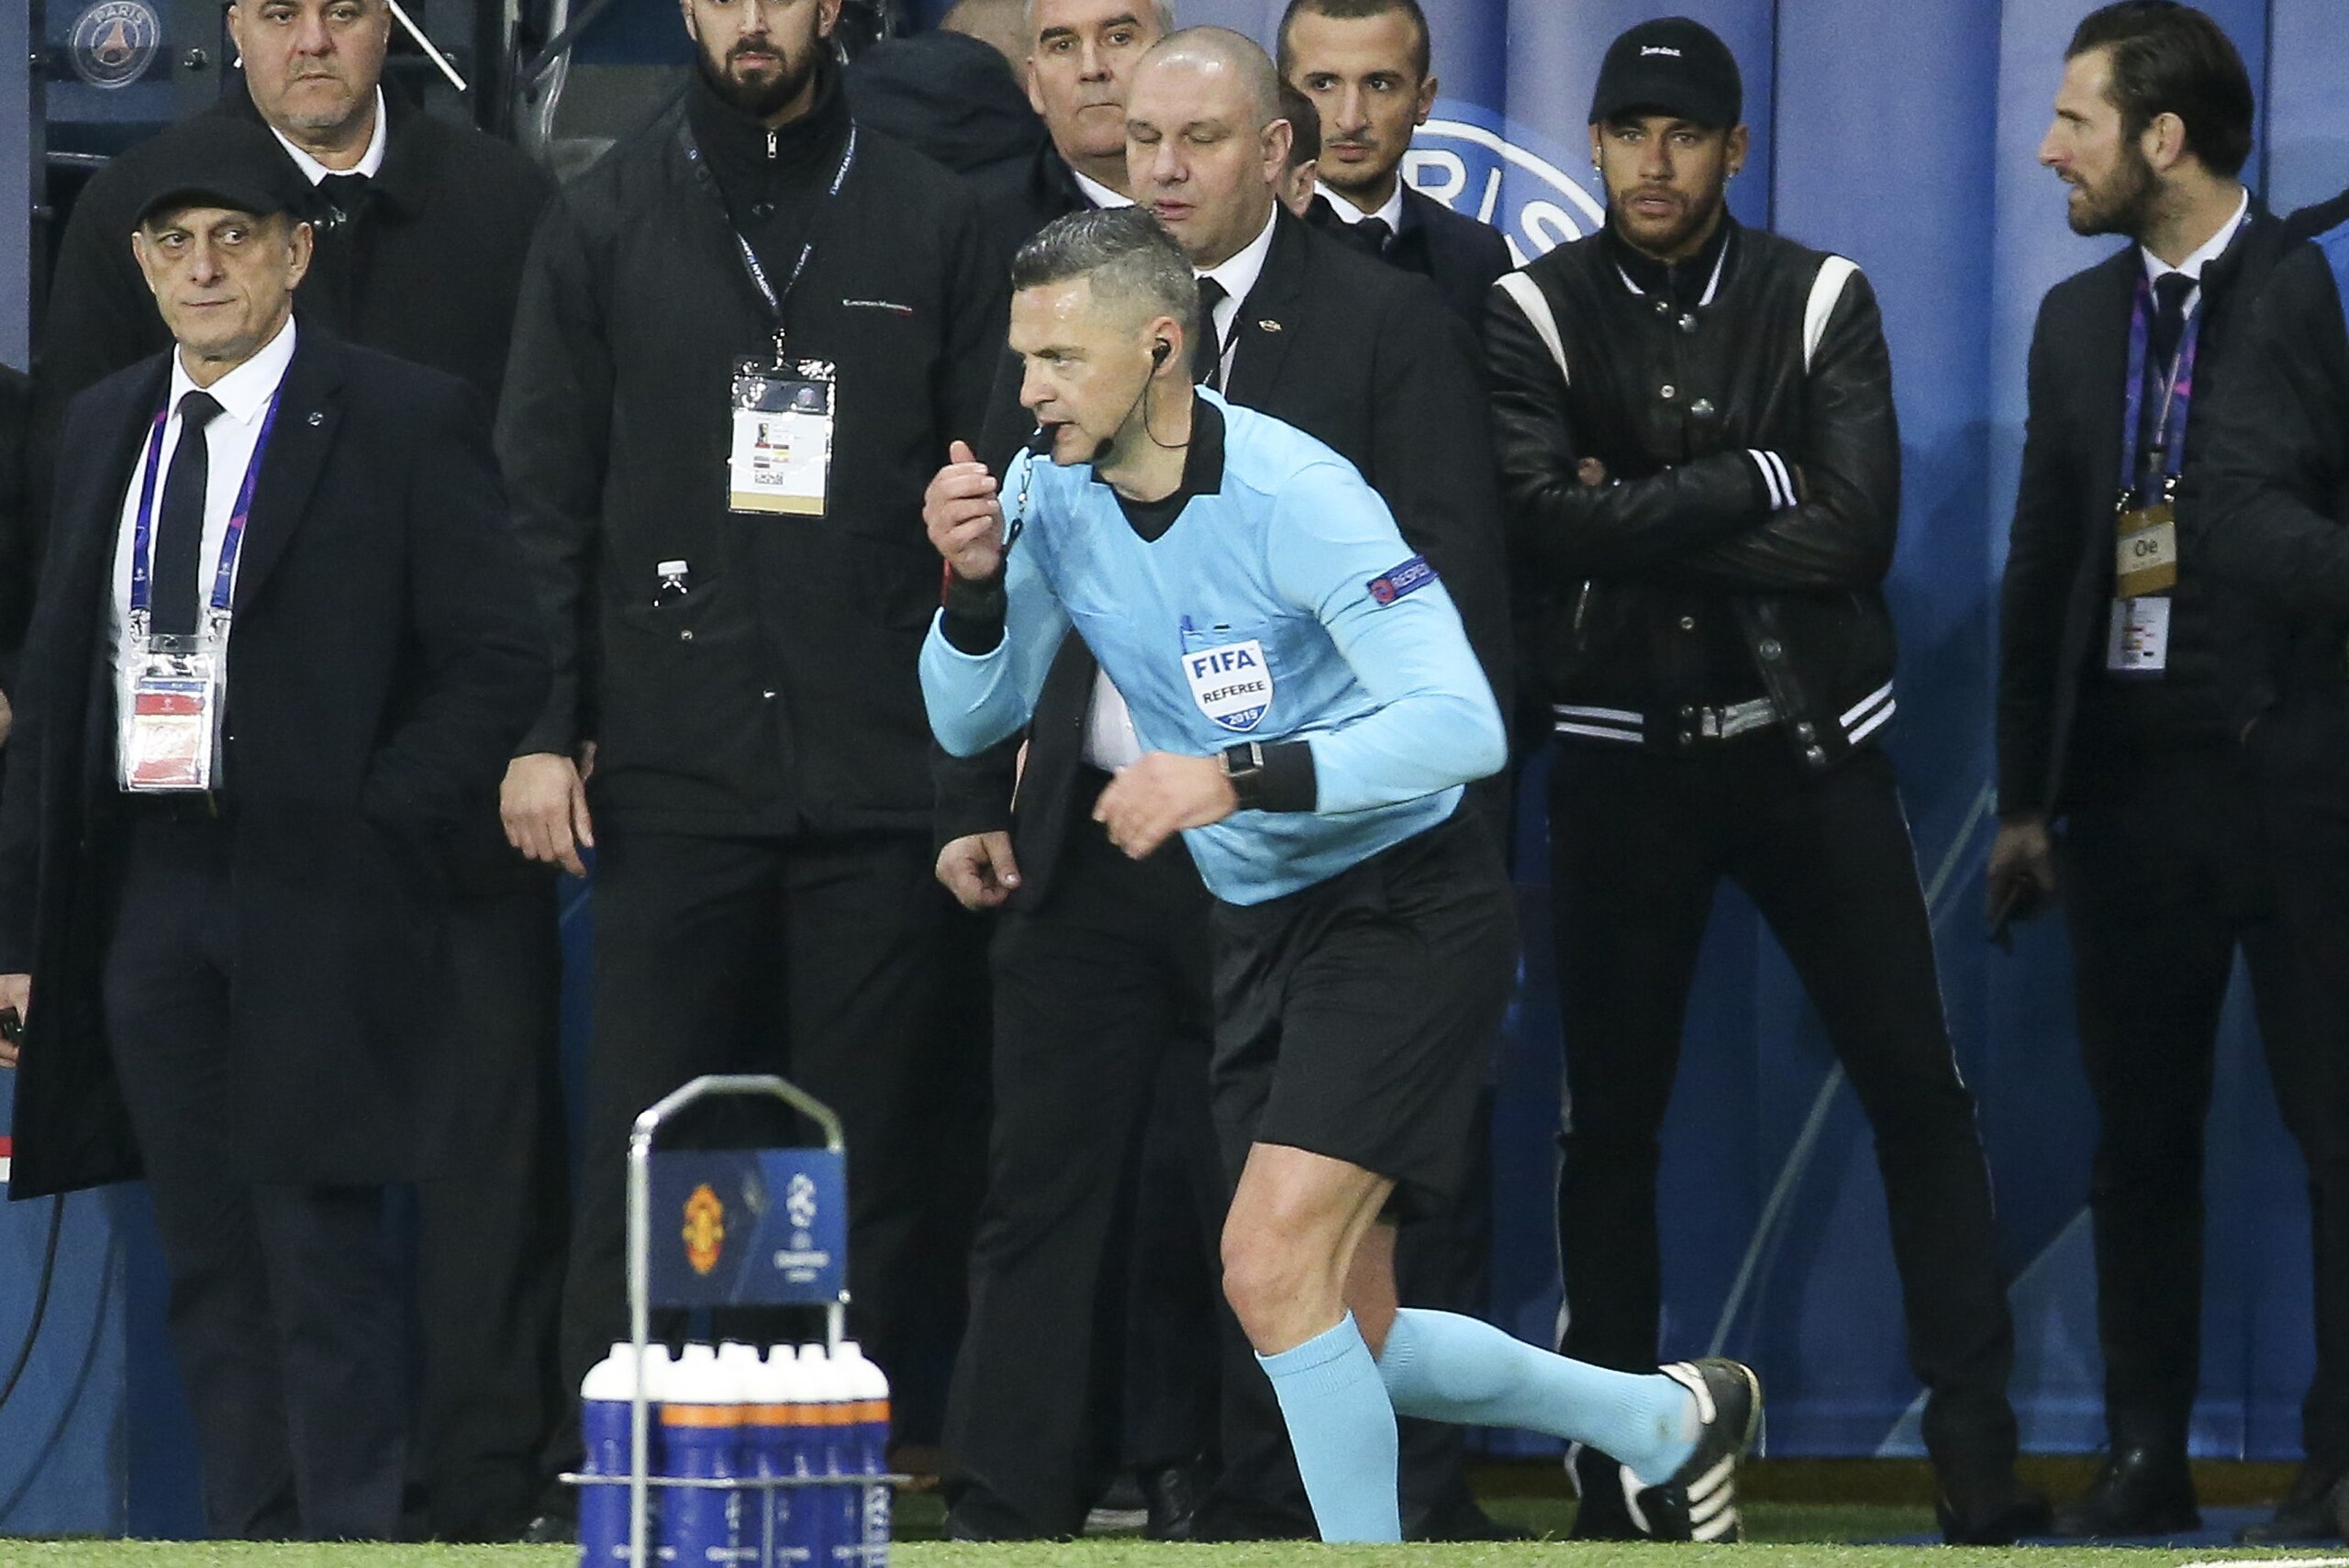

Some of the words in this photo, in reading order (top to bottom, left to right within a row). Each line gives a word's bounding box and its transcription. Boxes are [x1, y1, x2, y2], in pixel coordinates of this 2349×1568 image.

[1400, 148, 1583, 270] RIS
[1191, 649, 1256, 679] FIFA
[1202, 680, 1266, 704] REFEREE
